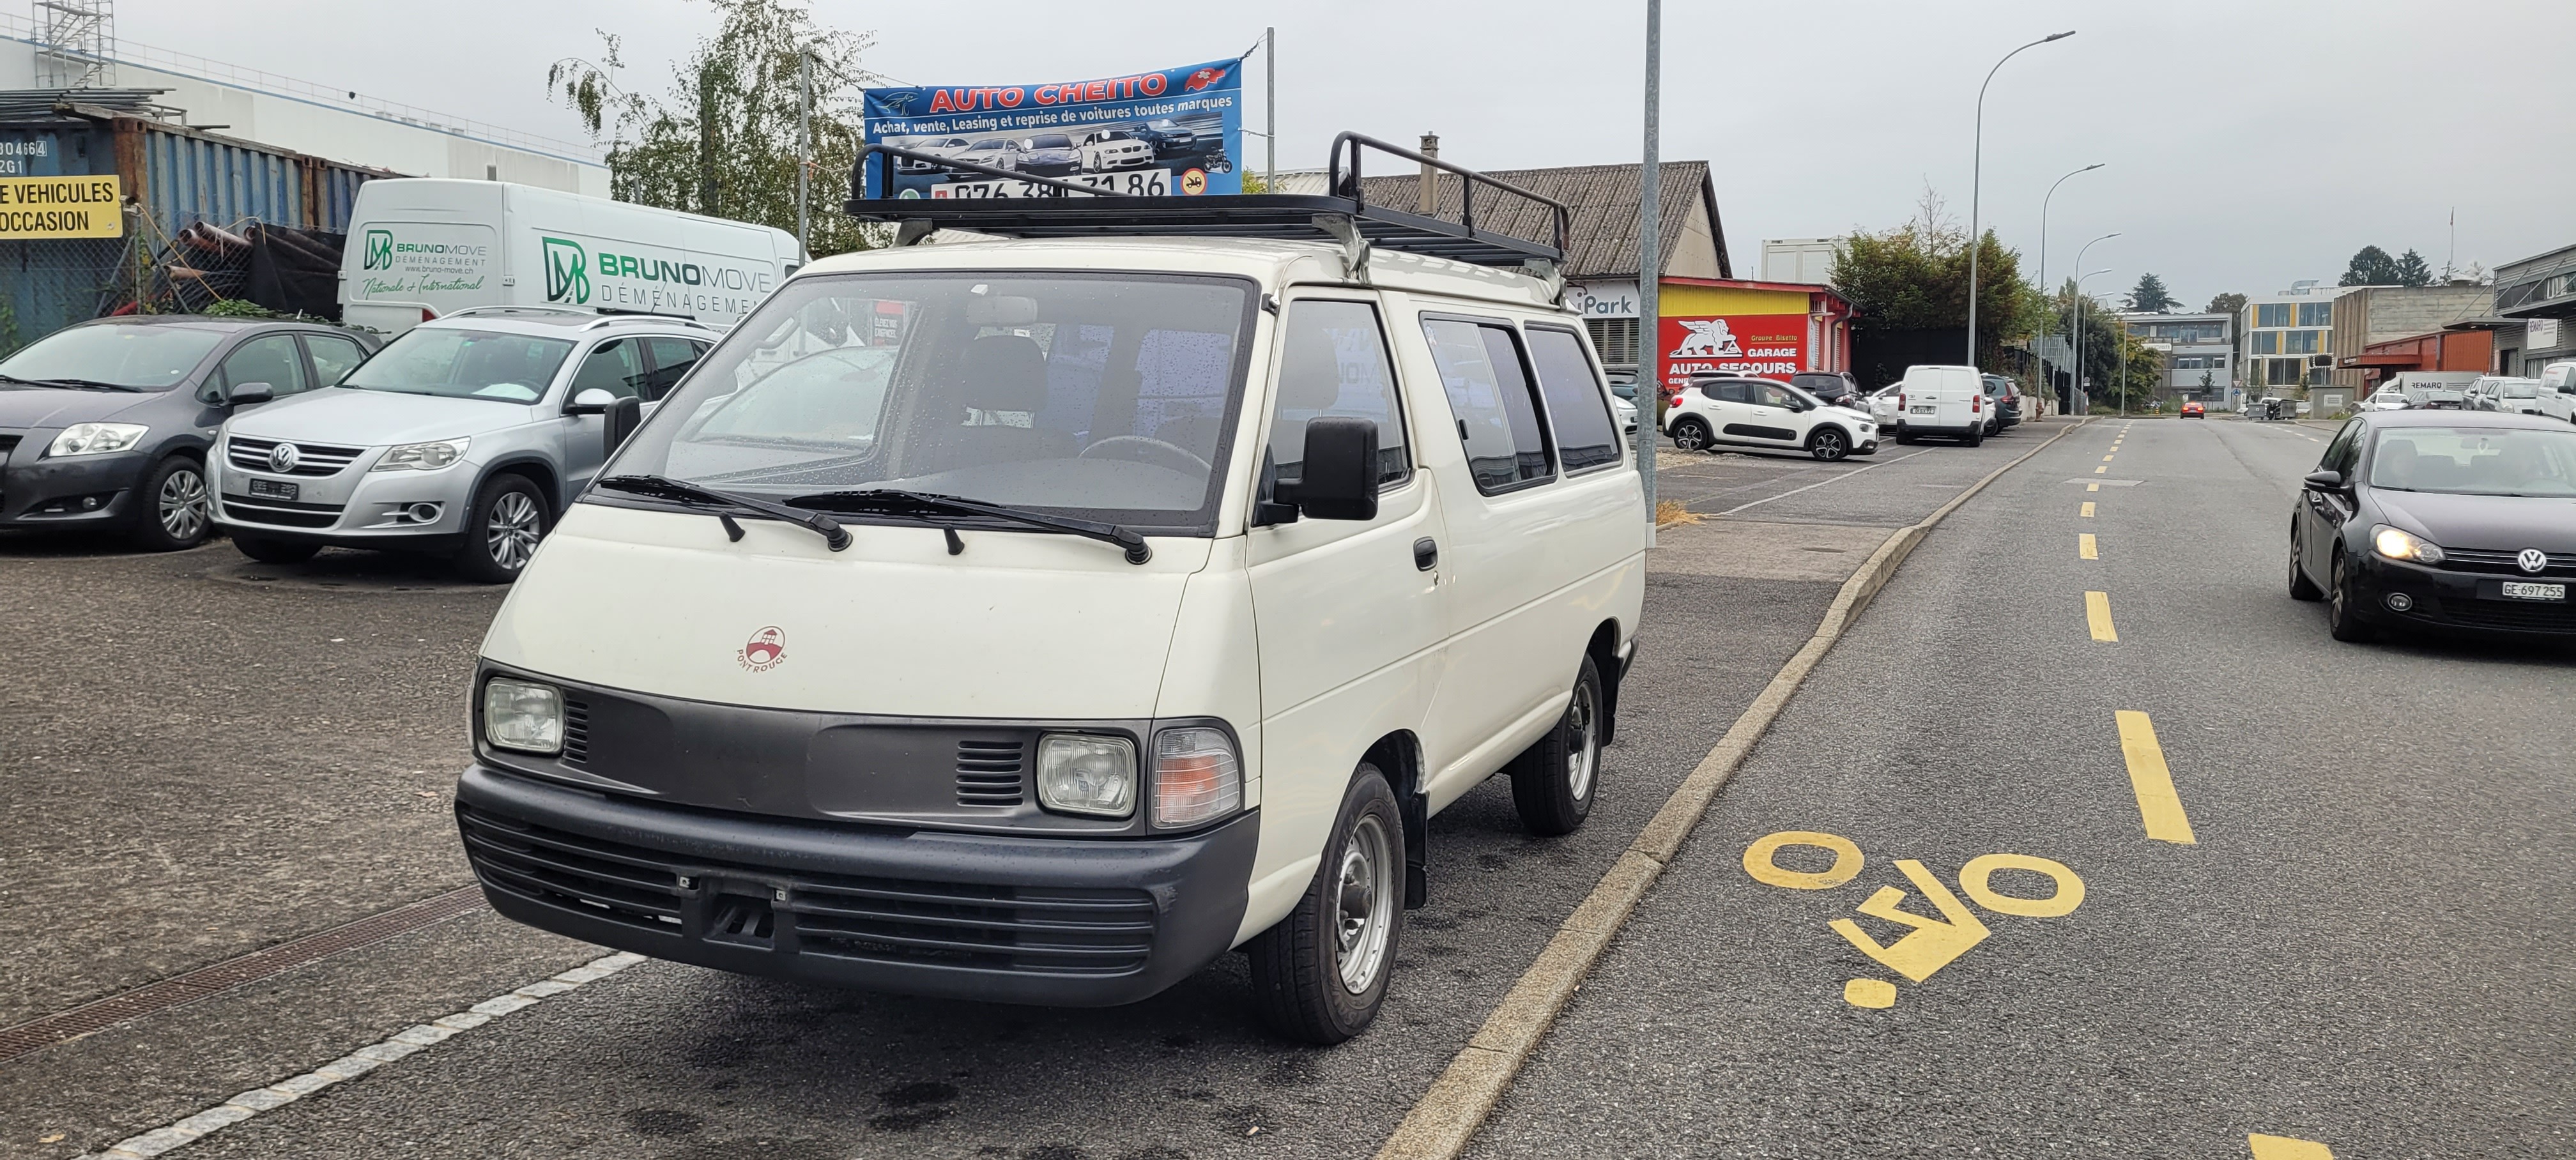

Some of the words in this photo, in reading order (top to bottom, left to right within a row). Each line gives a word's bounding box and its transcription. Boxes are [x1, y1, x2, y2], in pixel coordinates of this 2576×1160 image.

[930, 87, 1024, 113] AUTO
[1034, 73, 1167, 105] CHEITO
[873, 121, 909, 134] Achat,
[914, 120, 949, 133] vente,
[953, 115, 997, 130] Leasing
[1000, 116, 1013, 126] et
[1016, 111, 1057, 128] reprise
[1061, 110, 1077, 121] de
[1079, 106, 1131, 120] voitures
[1134, 103, 1174, 116] toutes
[1177, 96, 1232, 112] marques
[14, 182, 114, 204] VEHICULES
[1128, 172, 1165, 196] 86
[396, 243, 486, 256] BRUNOMOVE
[404, 266, 473, 274] www.bruno-move.ch
[598, 252, 772, 293] BRUNOMOVE
[602, 282, 758, 315] DÉMÉNAGEME
[1747, 348, 1797, 357] GARAGE
